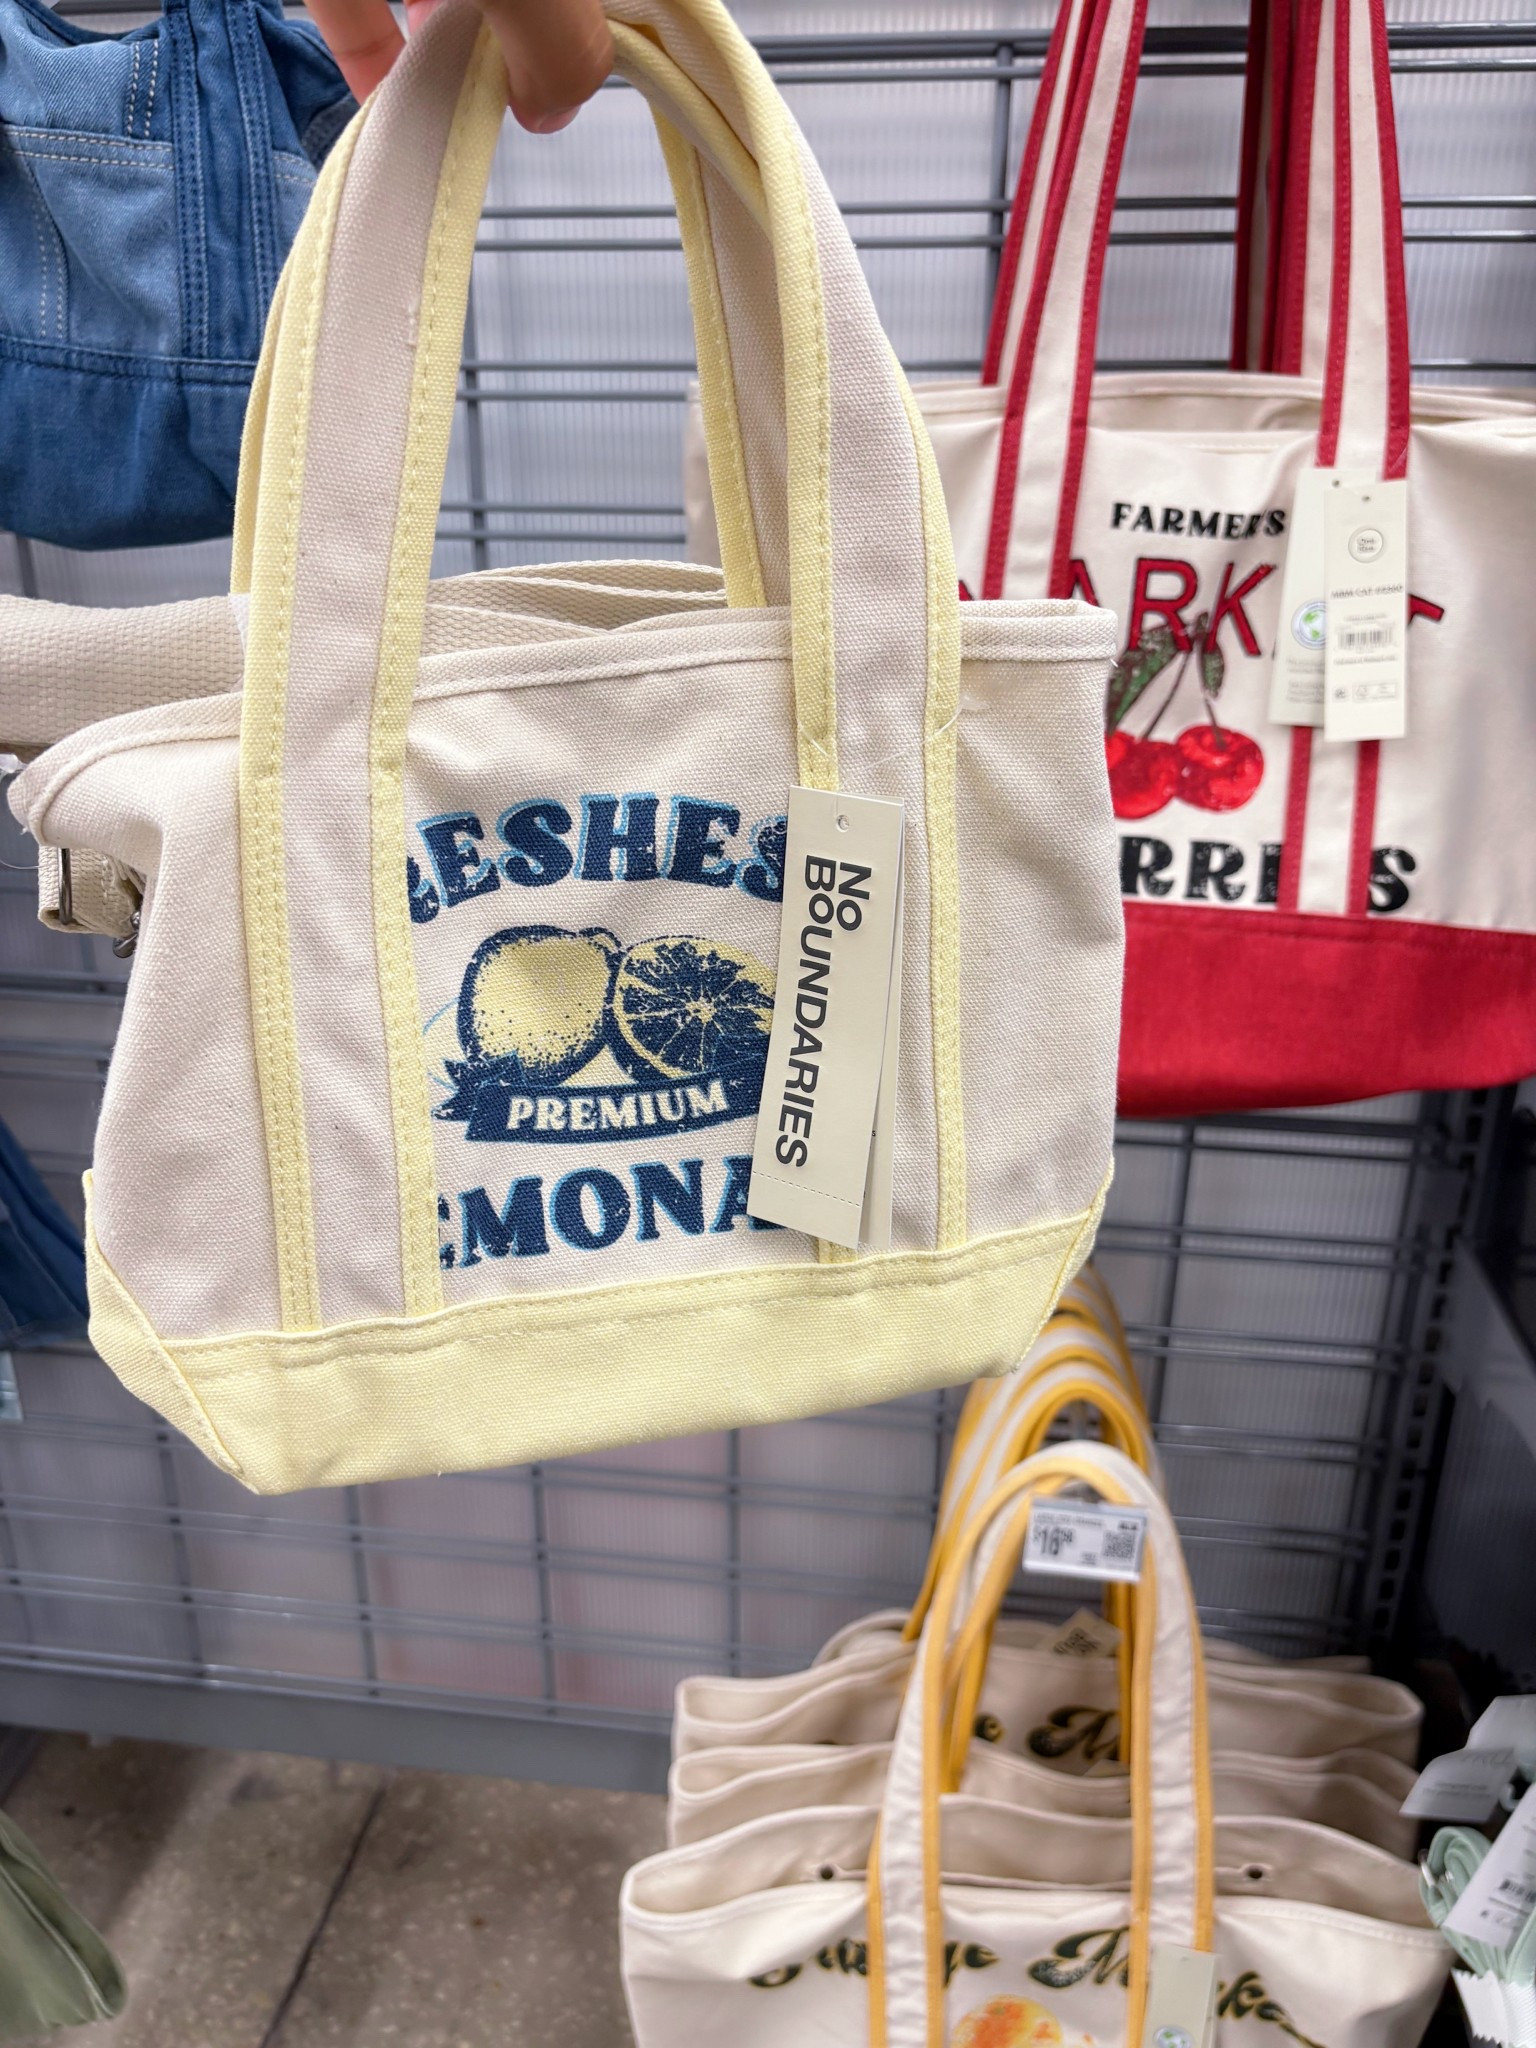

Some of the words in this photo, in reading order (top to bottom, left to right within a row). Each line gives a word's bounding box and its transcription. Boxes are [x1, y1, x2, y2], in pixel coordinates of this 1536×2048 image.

[836, 860, 873, 932] NO
[774, 854, 838, 1168] BOUNDARIES
[506, 1078, 730, 1131] PREMIUM
[437, 1154, 790, 1269] MONA
